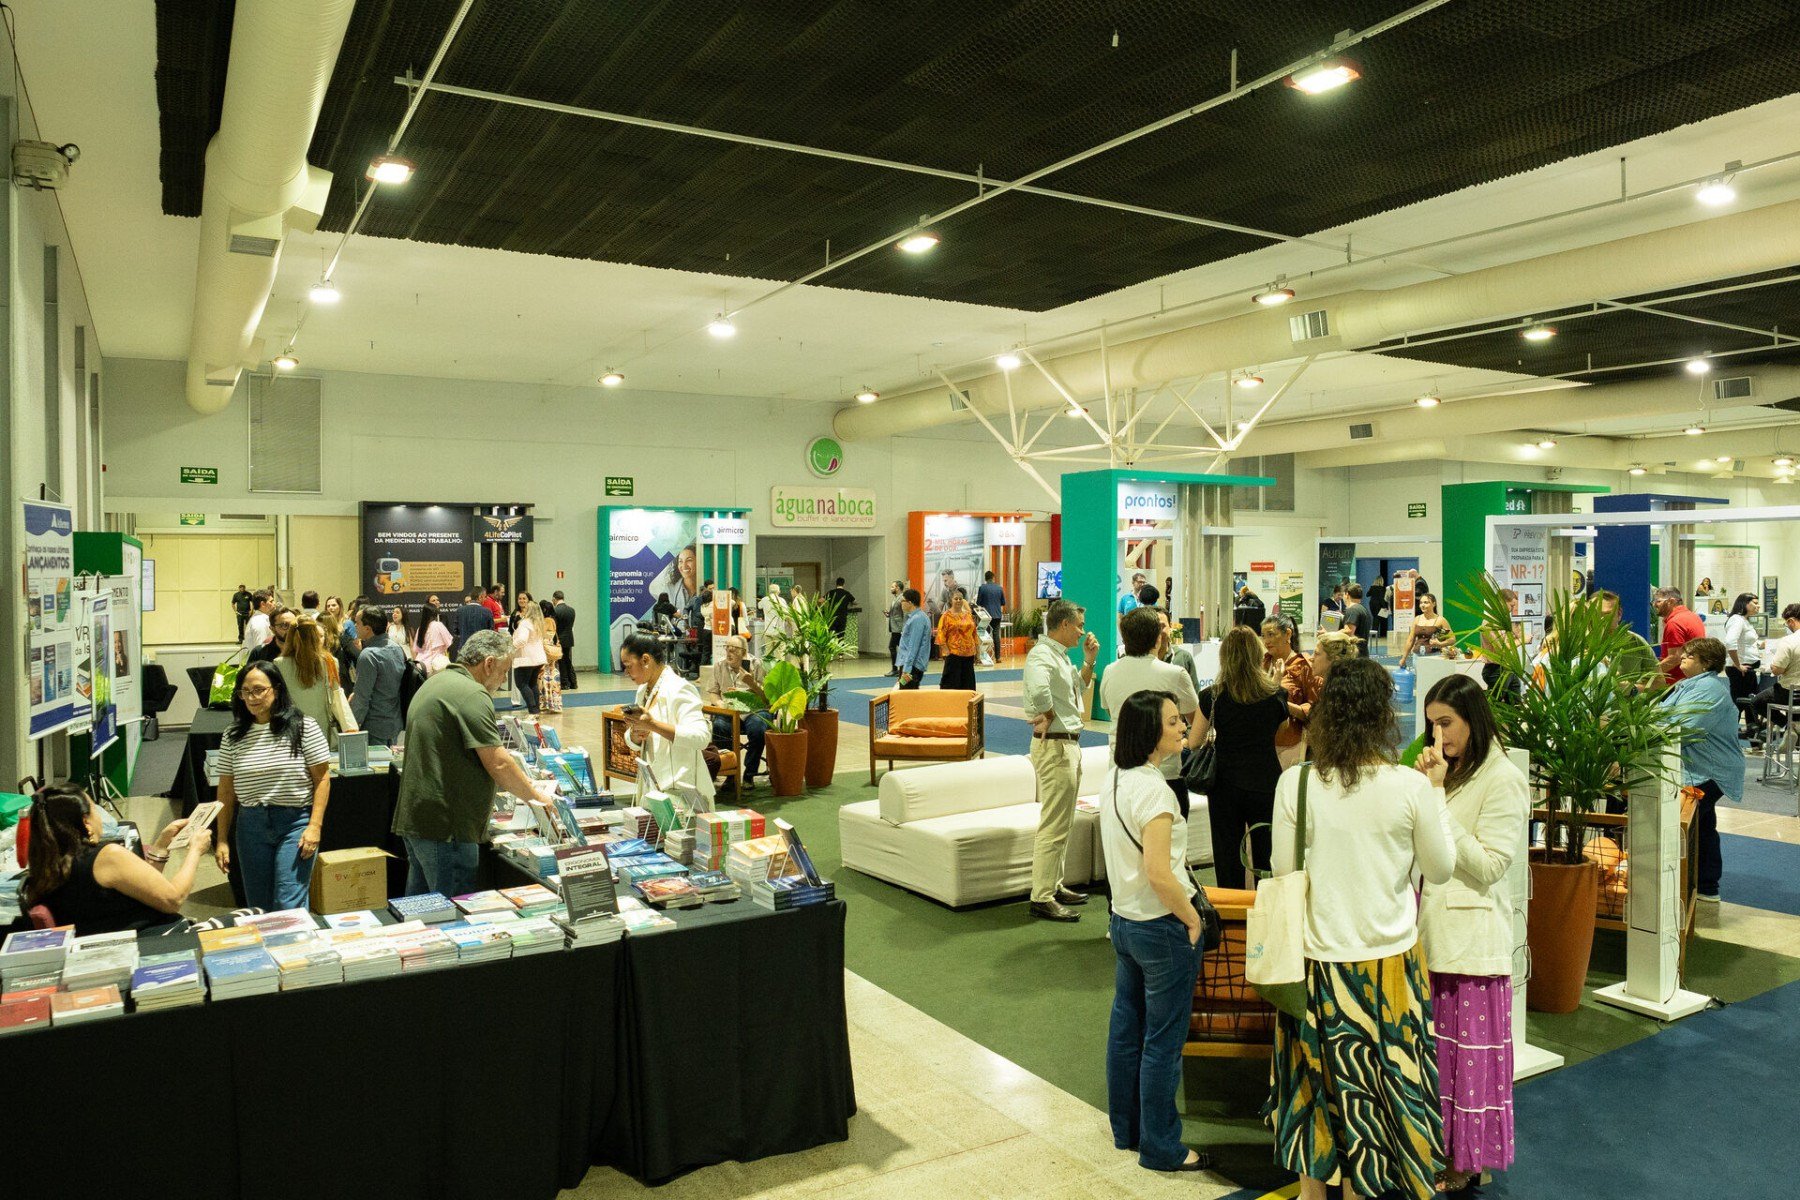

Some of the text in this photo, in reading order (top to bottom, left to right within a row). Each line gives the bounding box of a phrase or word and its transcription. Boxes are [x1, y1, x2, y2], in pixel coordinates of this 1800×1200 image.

[1125, 493, 1176, 510] prontos!
[716, 526, 744, 535] airmicro
[642, 571, 655, 579] que
[1511, 563, 1545, 579] NR-1?
[565, 860, 602, 872] INTEGRAL
